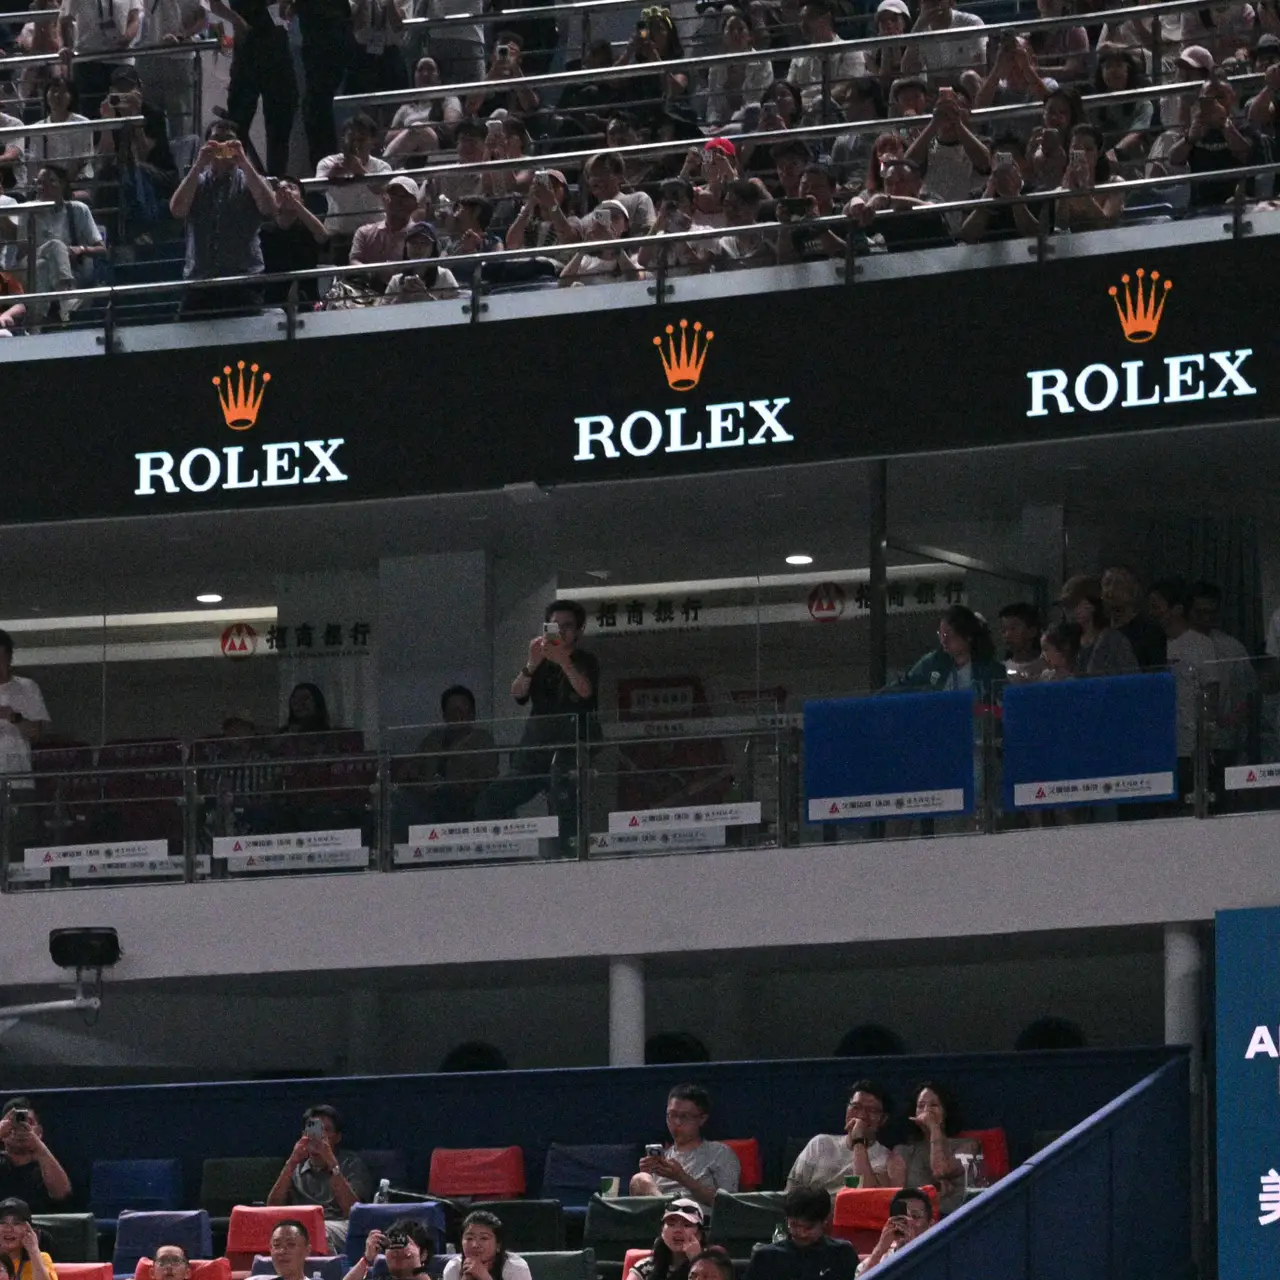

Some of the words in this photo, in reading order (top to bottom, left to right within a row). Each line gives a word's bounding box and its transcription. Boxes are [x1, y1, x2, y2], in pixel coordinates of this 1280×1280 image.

[1027, 349, 1256, 416] ROLEX
[574, 398, 794, 460] ROLEX
[135, 439, 348, 495] ROLEX
